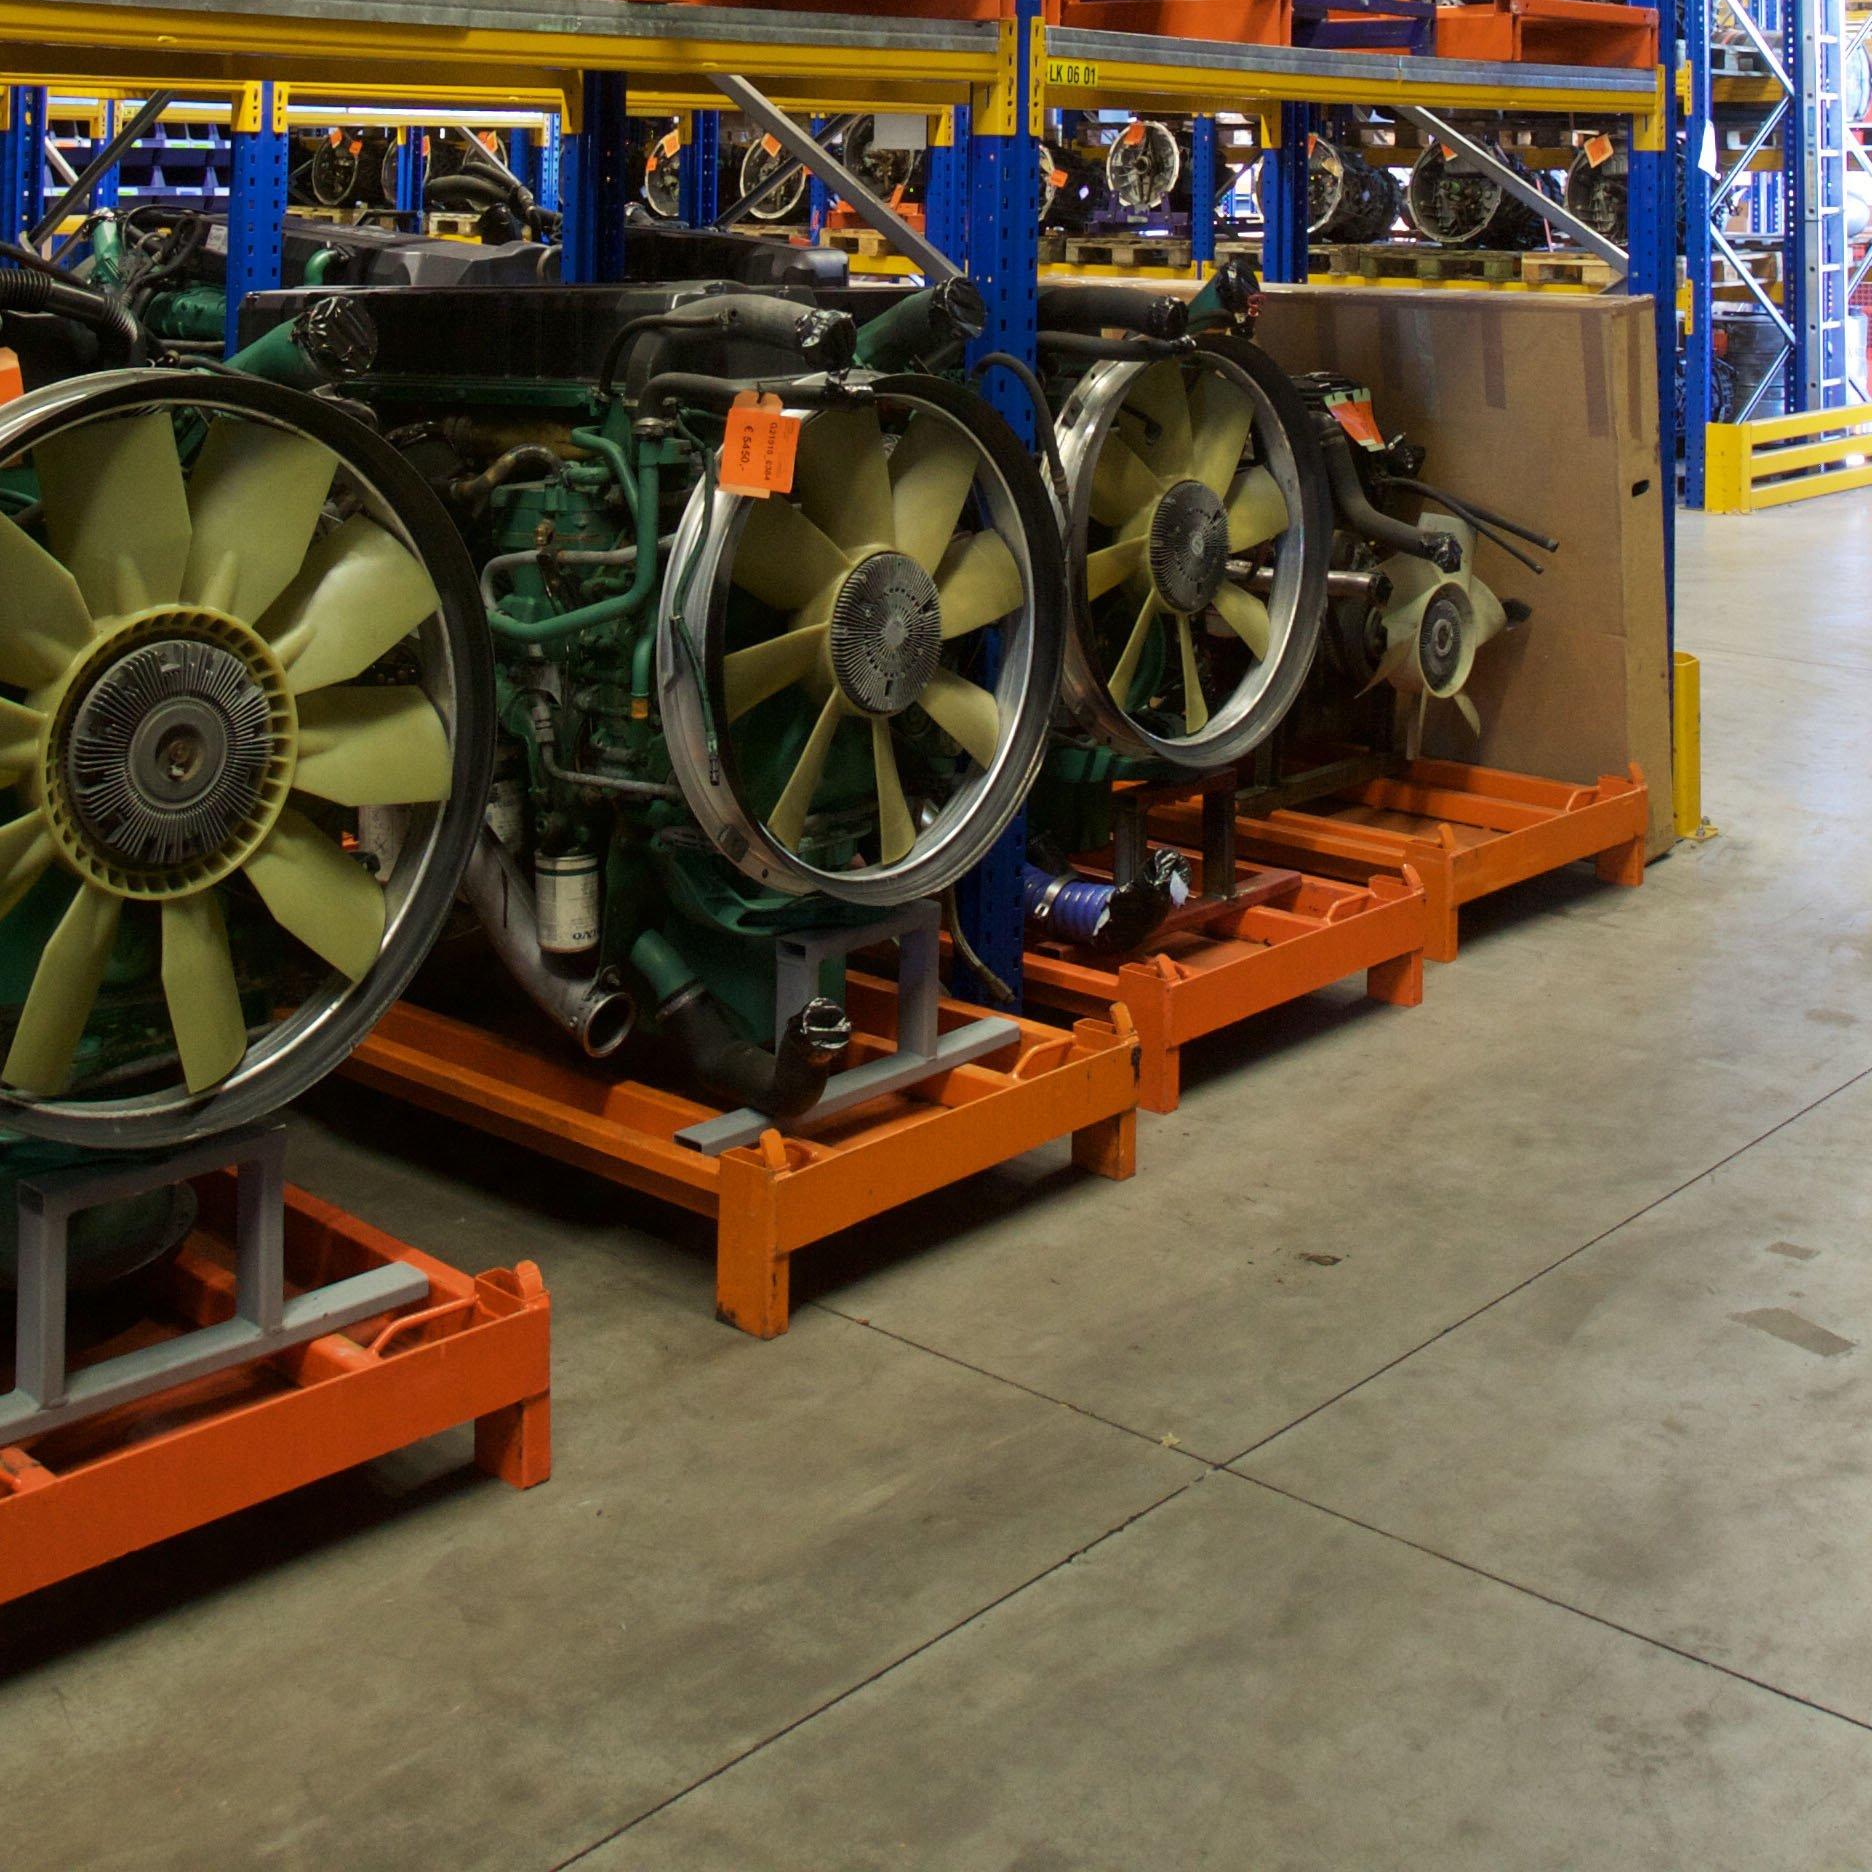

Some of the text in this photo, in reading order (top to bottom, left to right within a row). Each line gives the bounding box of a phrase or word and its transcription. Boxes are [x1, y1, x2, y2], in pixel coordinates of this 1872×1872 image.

[1049, 63, 1096, 86] LK 06 01
[743, 425, 754, 434] €
